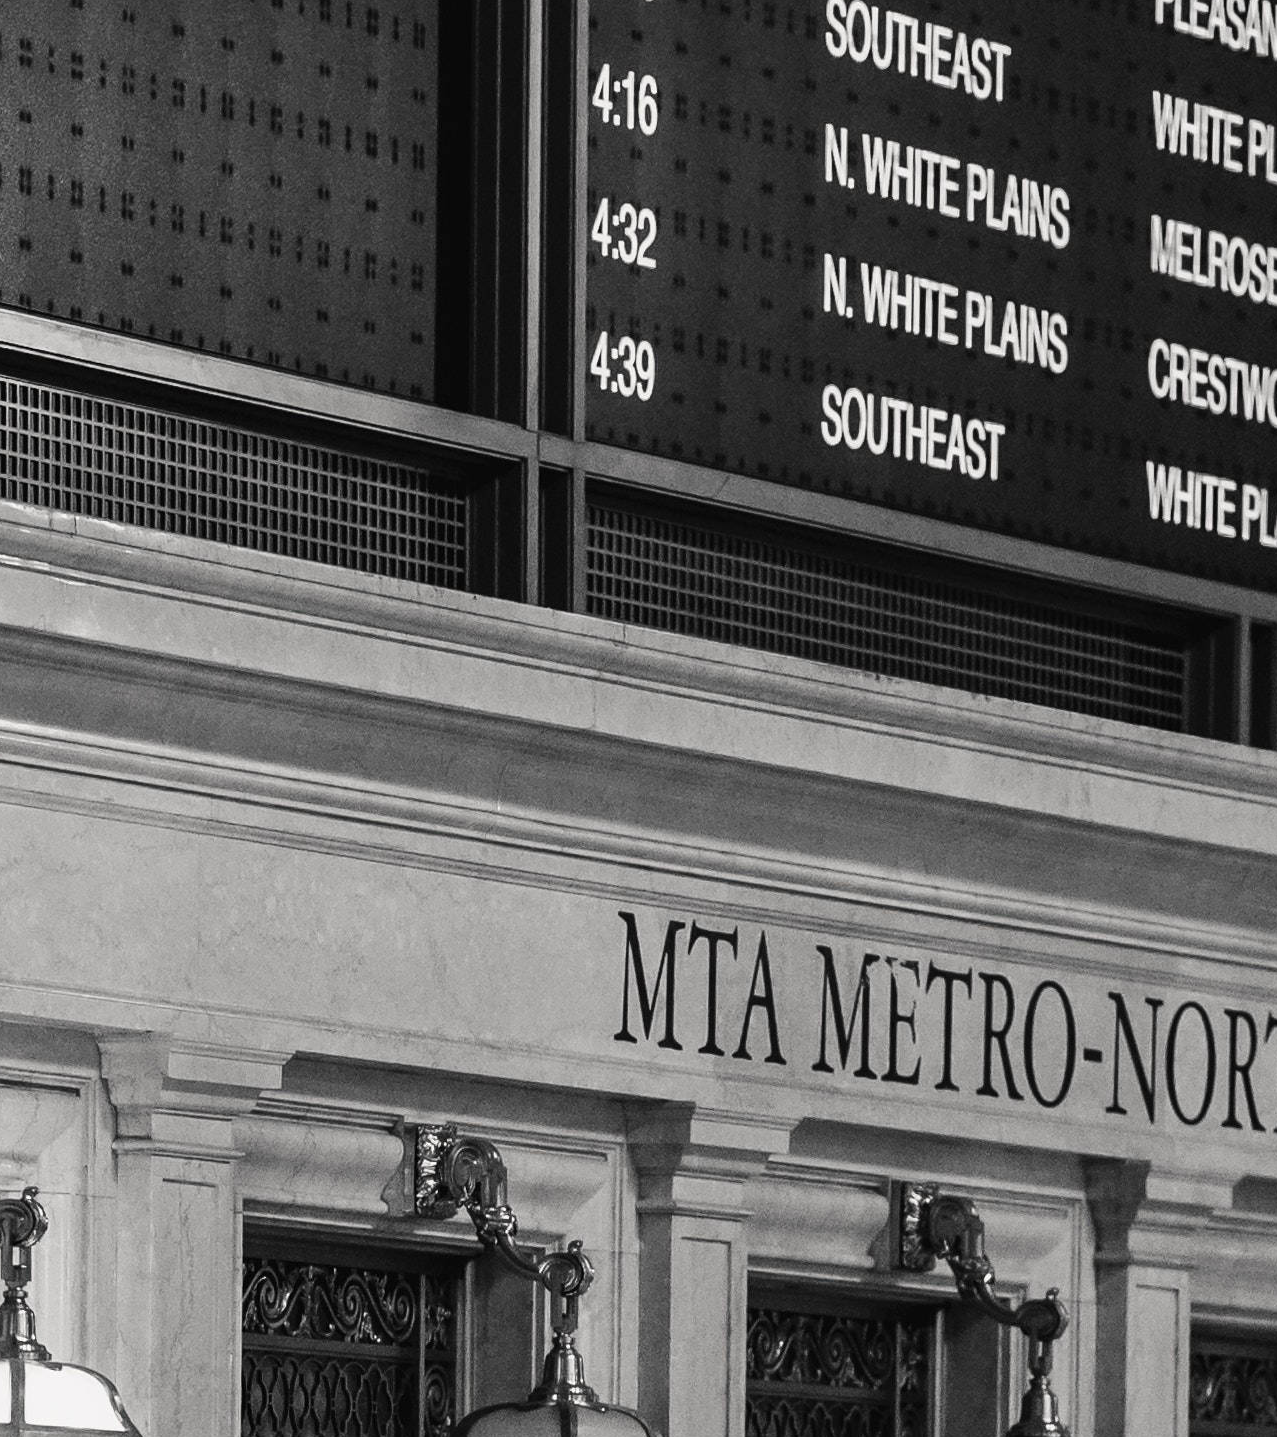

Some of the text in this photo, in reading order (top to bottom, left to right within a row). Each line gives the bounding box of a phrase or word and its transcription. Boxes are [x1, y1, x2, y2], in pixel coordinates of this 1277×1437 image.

[592, 64, 657, 135] 4:16
[1153, 91, 1243, 172] WHITE
[825, 124, 1069, 248] N. WHITE PLAINS
[592, 198, 656, 269] 4:32
[824, 254, 1067, 373] N. WHITE PLAINS
[591, 331, 655, 401] 4:39
[821, 384, 1005, 480] SOUTHEAST
[1146, 461, 1236, 537] WHITE
[614, 910, 786, 1068] MTA
